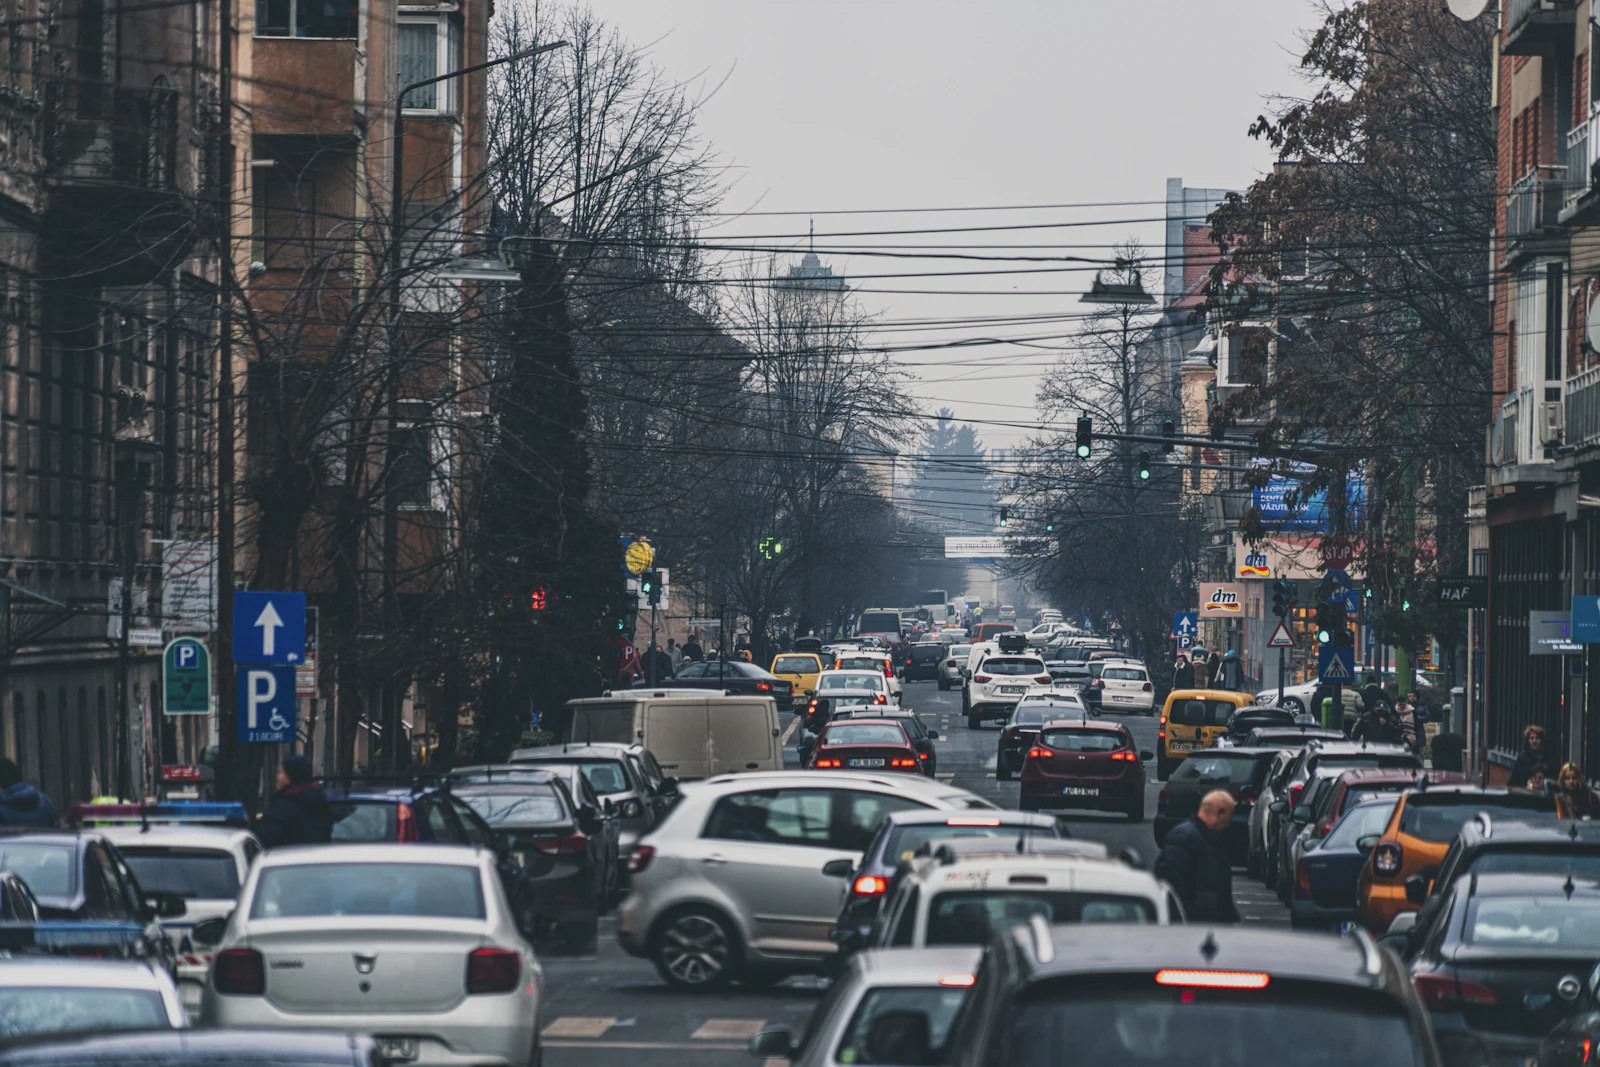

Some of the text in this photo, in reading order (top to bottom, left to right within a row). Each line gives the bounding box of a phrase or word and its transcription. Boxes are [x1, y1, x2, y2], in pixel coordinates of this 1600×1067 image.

[1244, 553, 1268, 567] dm
[1212, 588, 1237, 604] dm
[1440, 586, 1470, 600] HAF
[1182, 637, 1190, 648] P
[180, 647, 195, 667] P
[247, 670, 277, 729] P
[248, 732, 284, 742] 2 LOCURI
